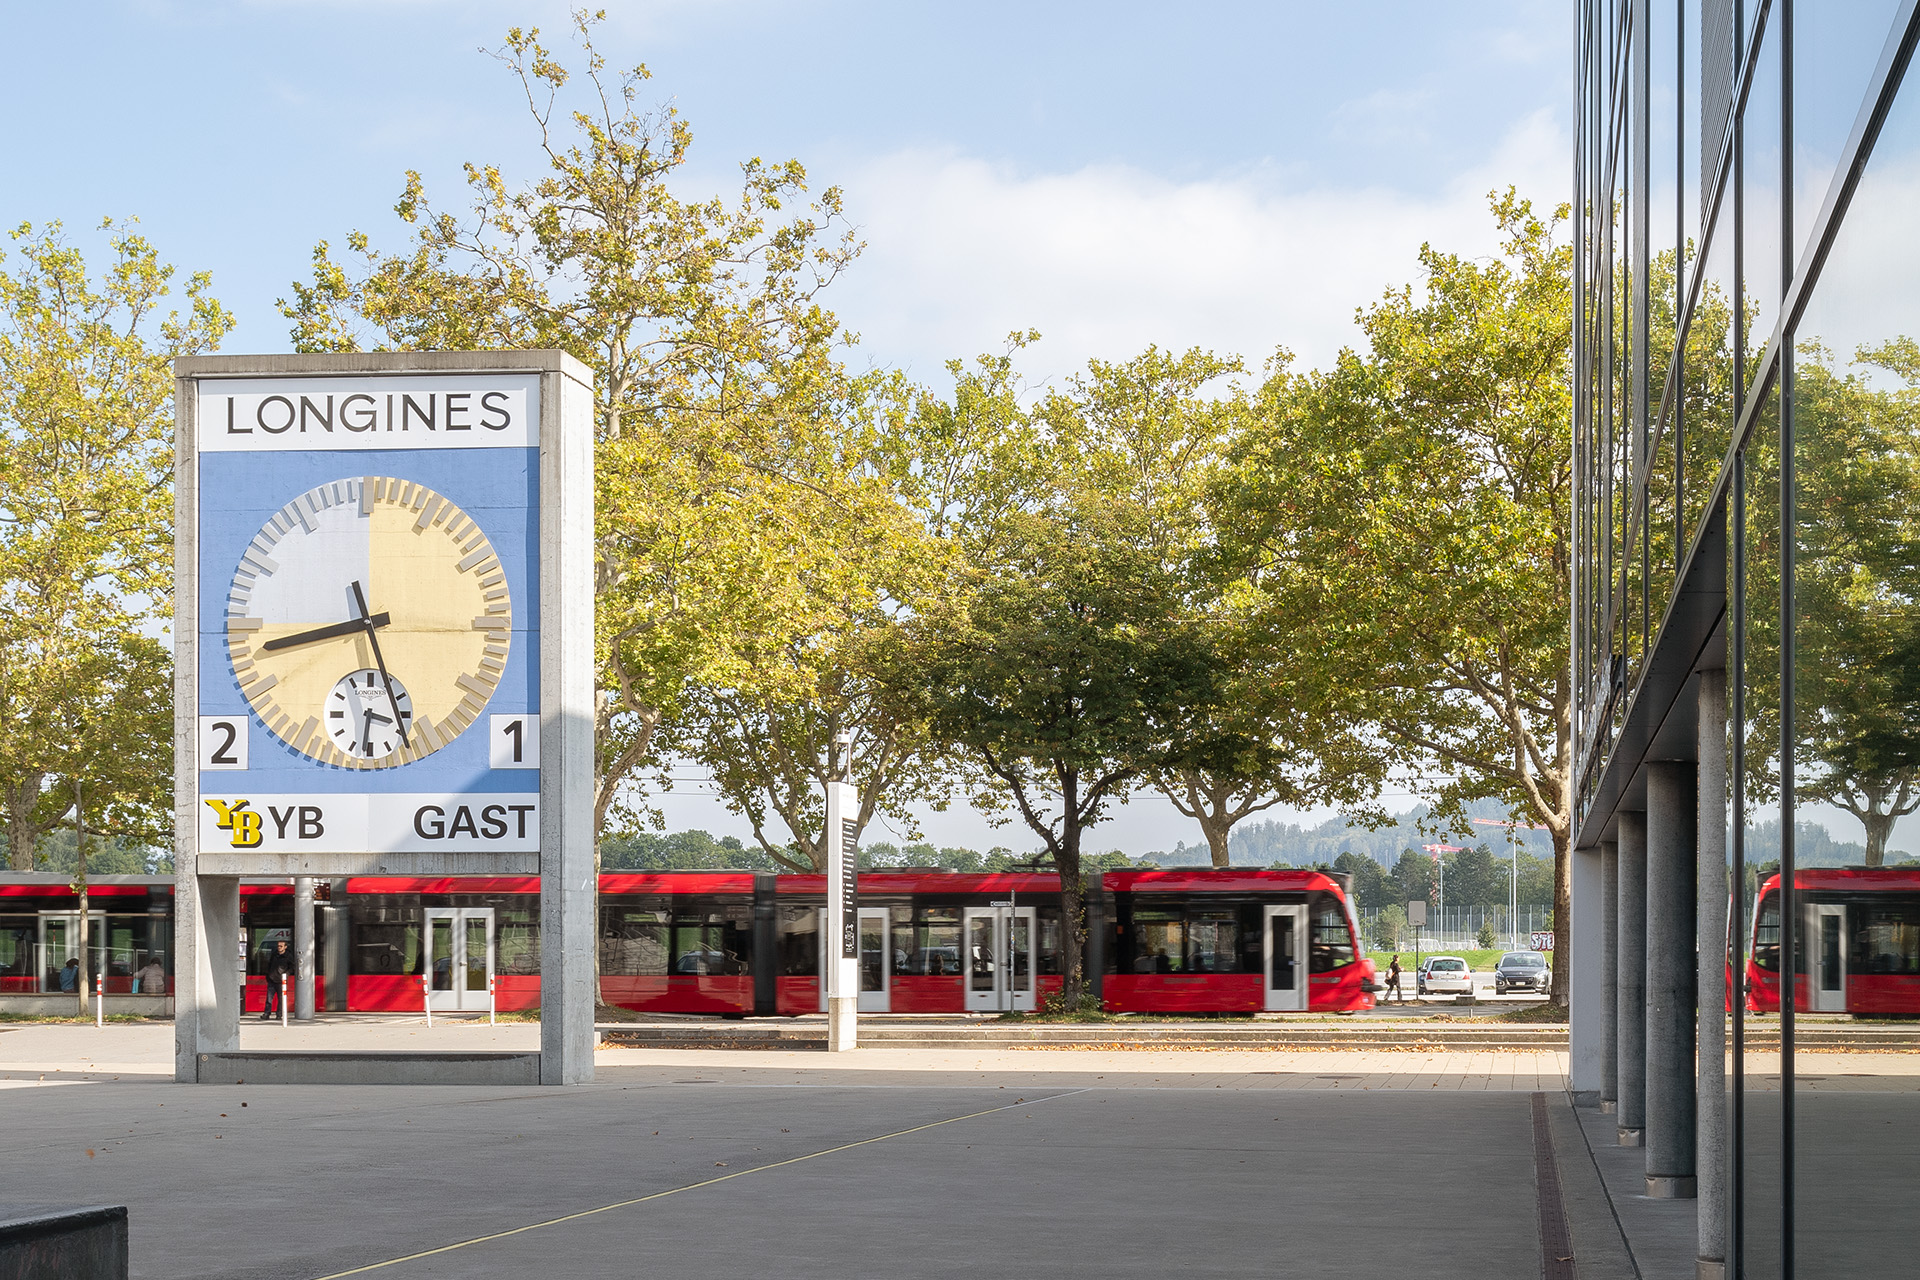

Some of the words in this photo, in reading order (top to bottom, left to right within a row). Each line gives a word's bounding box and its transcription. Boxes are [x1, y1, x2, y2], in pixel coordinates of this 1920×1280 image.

[227, 391, 511, 434] LONGINES
[210, 722, 237, 764] 2
[503, 720, 522, 763] 1
[267, 806, 324, 839] YB
[413, 805, 535, 840] GAST
